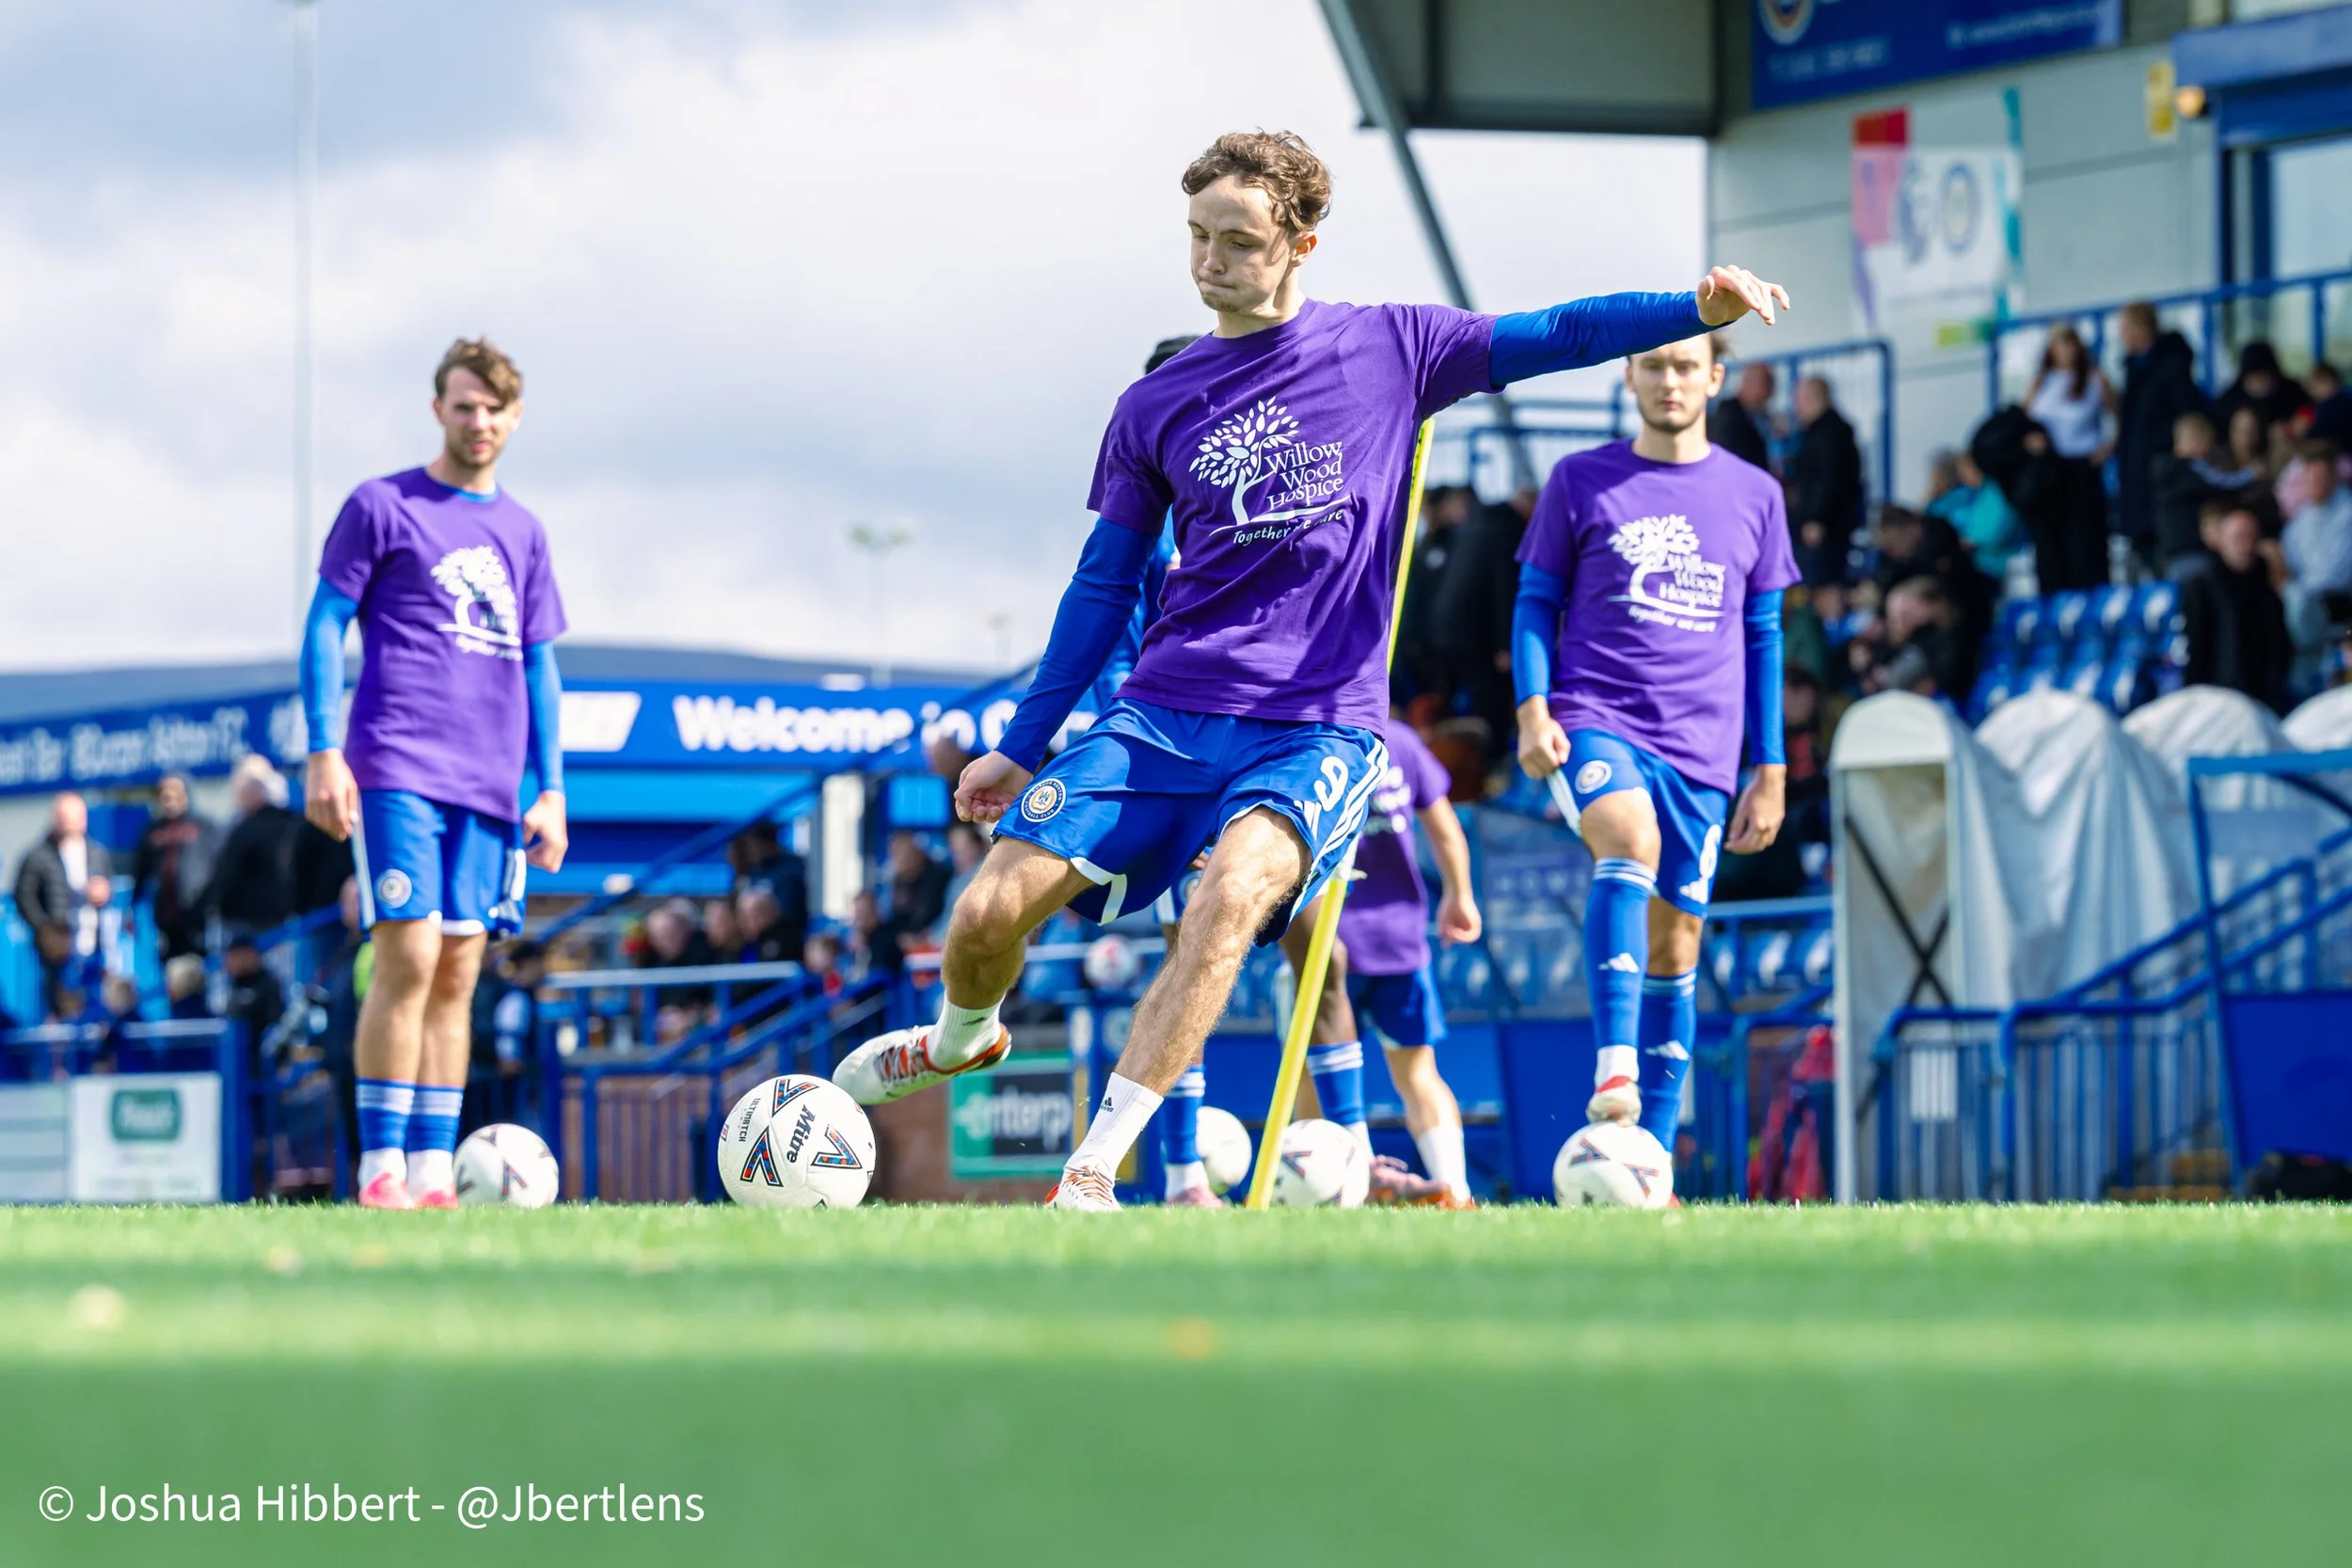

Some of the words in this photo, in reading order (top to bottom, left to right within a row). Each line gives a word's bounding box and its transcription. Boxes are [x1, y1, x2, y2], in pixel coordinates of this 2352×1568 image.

[1263, 441, 1343, 473] Willow
[1279, 451, 1343, 490] Wood
[1266, 478, 1343, 511] Hospice
[1233, 525, 1291, 546] Together
[672, 694, 914, 753] Welcome
[738, 1098, 762, 1143] ULTIMATCH
[787, 1104, 816, 1163] Mitre
